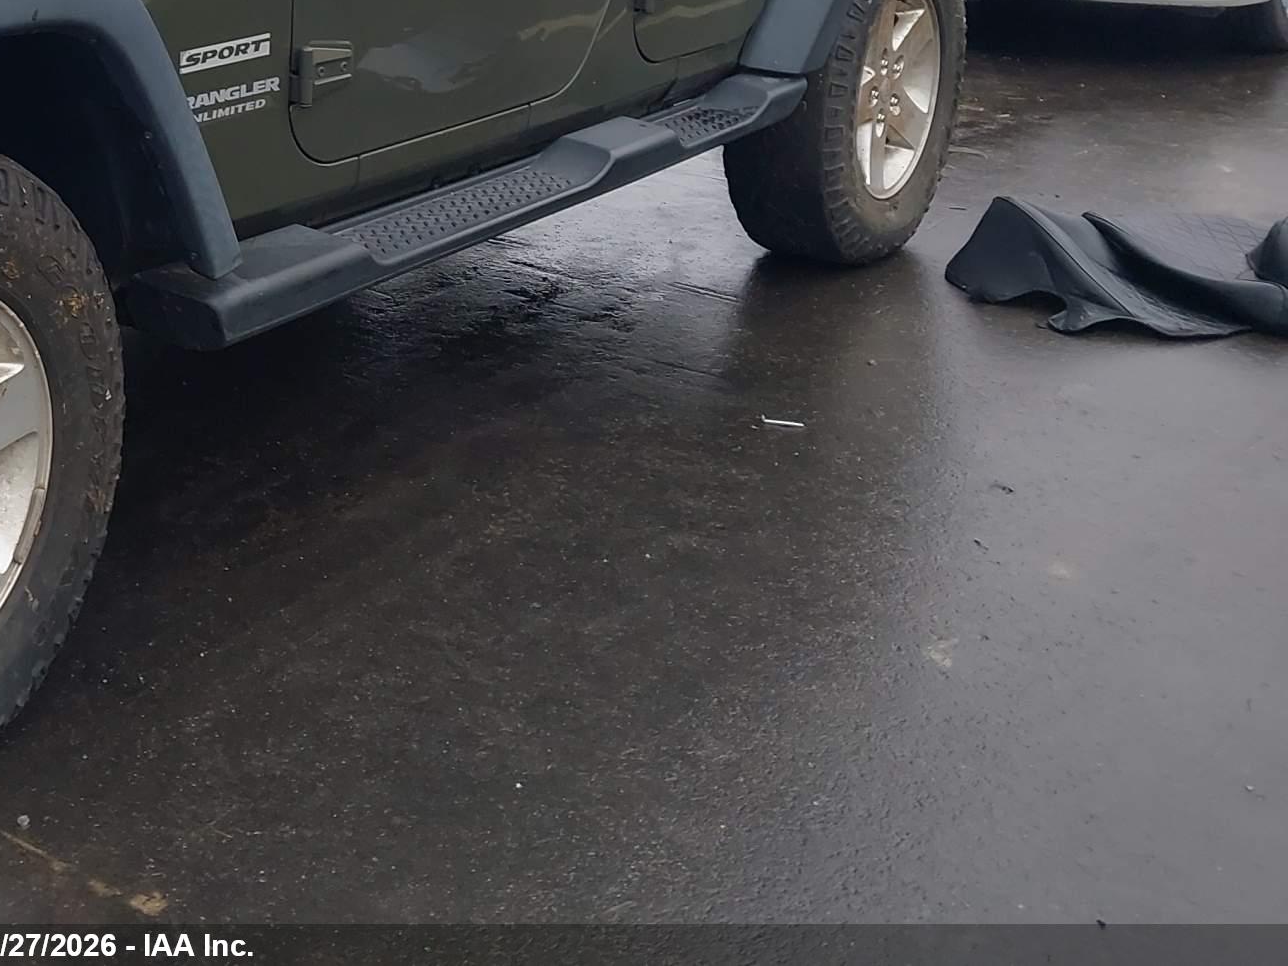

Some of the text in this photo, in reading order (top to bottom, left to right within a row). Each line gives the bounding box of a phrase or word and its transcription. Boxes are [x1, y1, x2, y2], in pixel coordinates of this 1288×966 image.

[182, 40, 267, 67] SPORT
[187, 77, 281, 110] RANGLER
[193, 99, 266, 123] NLIMITED
